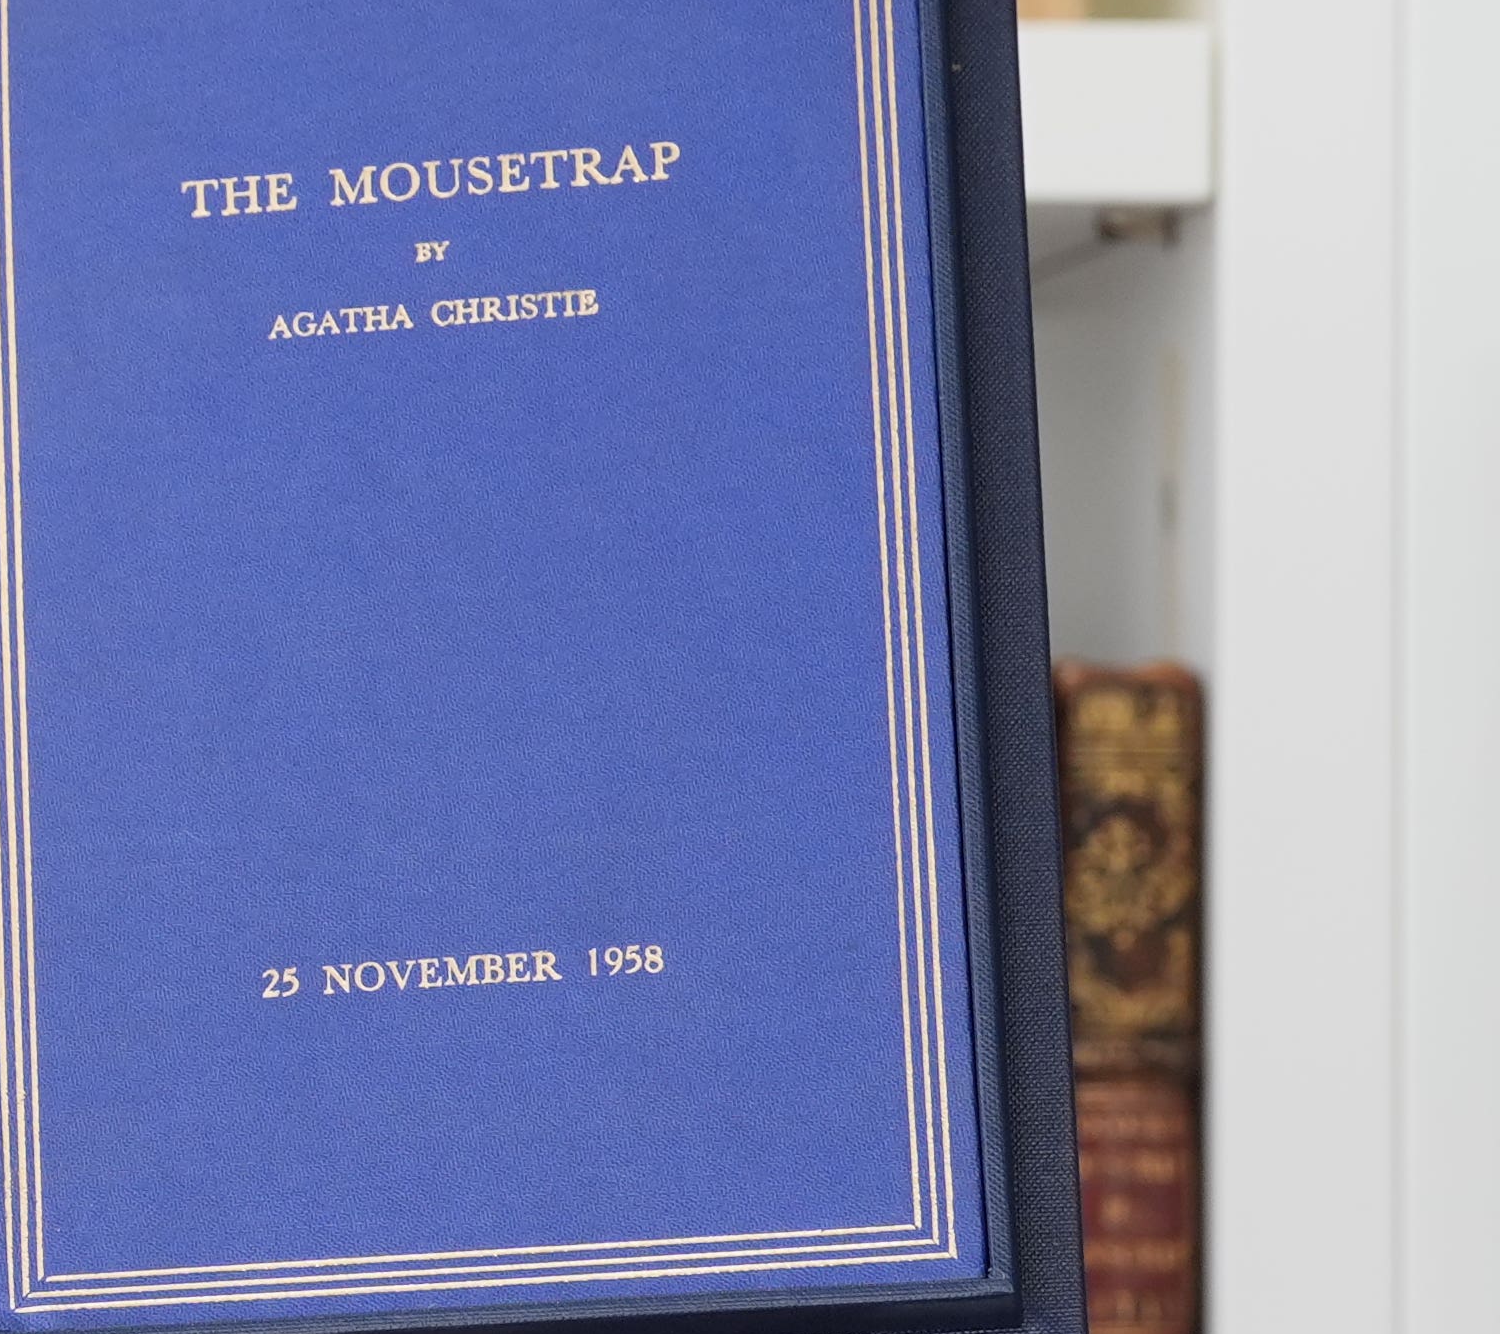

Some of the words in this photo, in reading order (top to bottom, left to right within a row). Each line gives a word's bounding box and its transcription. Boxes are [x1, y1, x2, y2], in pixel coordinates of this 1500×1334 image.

[181, 171, 298, 219] THE
[328, 140, 682, 207] MOUSETRAP
[414, 240, 451, 264] BY
[267, 301, 415, 341] AGATHA
[430, 288, 600, 327] CHRISTIE
[261, 966, 300, 1000] 25
[322, 950, 563, 996] NOVEMBER
[587, 944, 666, 978] 1958
